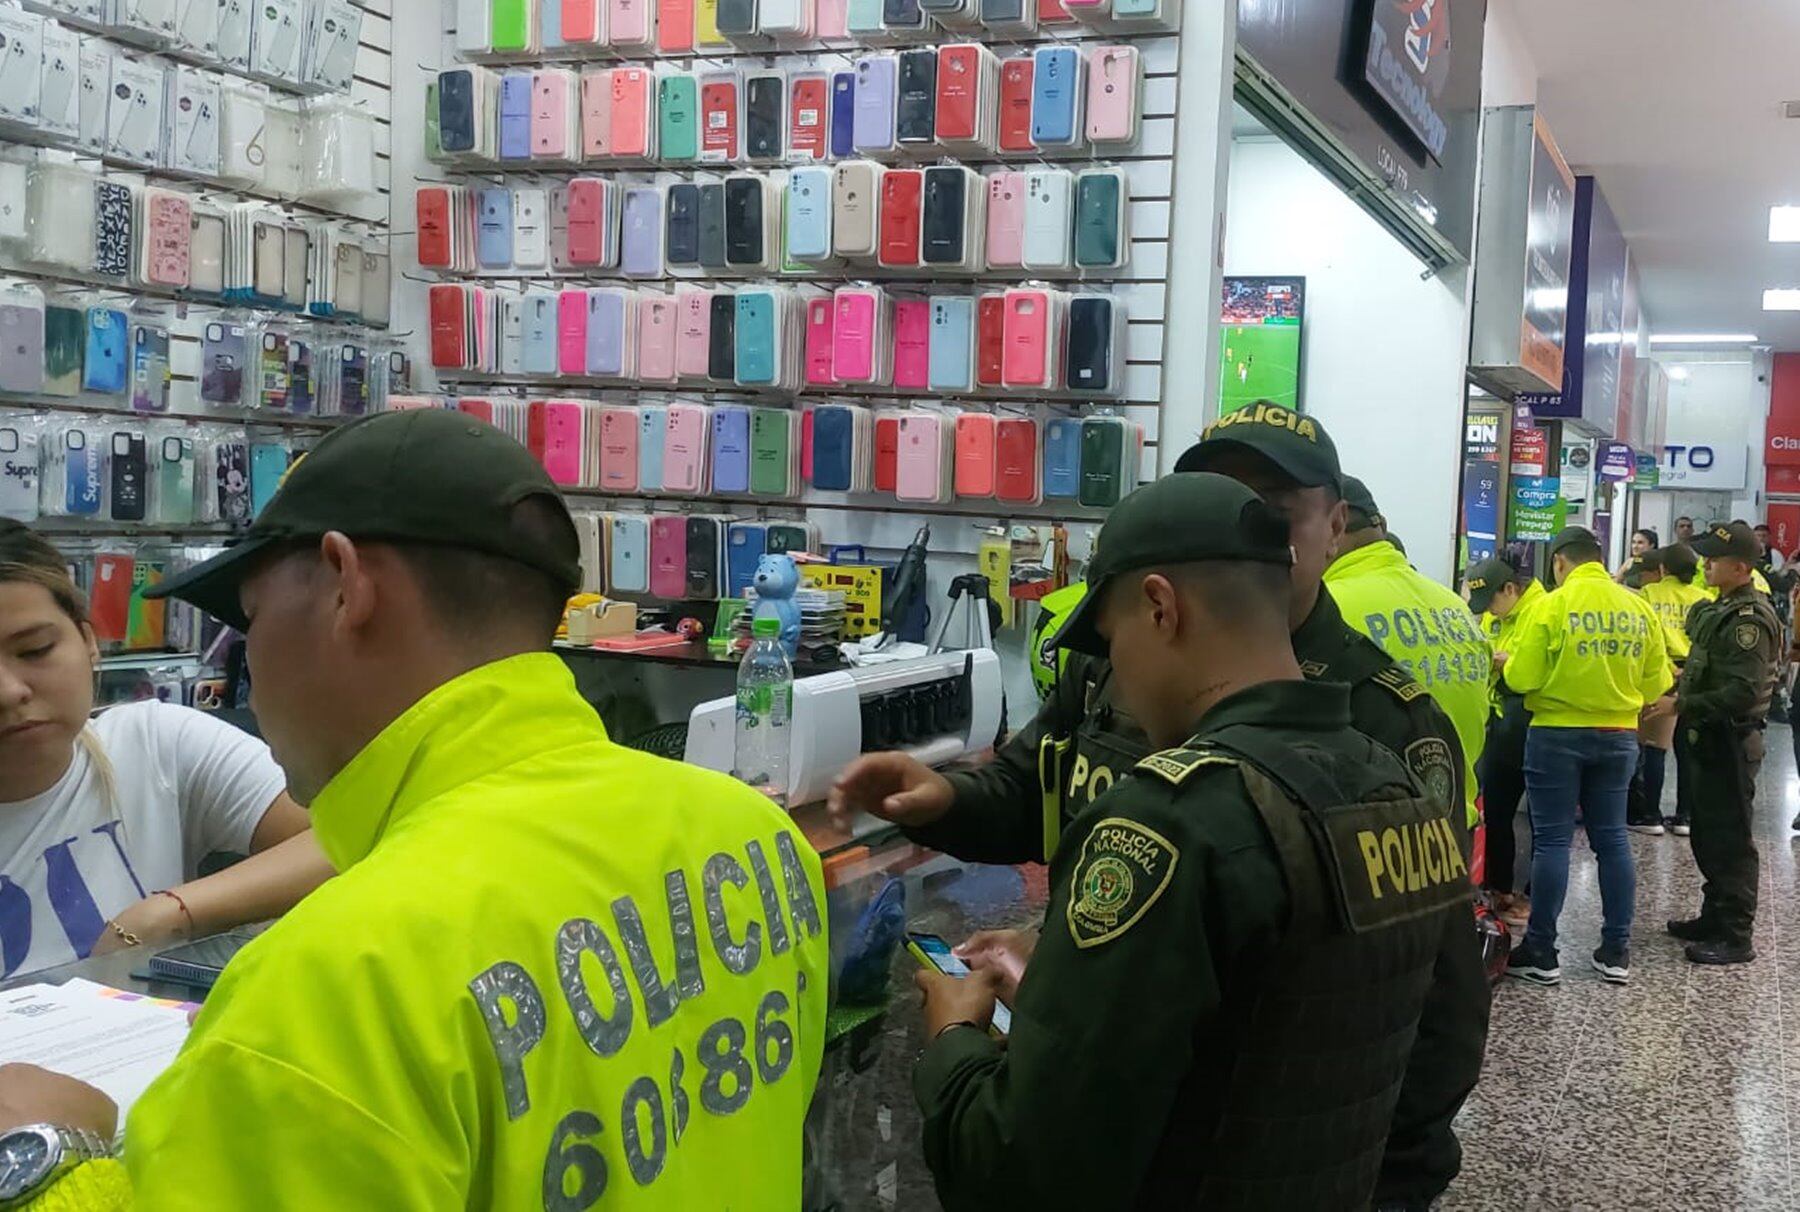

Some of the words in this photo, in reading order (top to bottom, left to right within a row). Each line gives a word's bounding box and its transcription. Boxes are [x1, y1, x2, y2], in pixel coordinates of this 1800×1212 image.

[1467, 424, 1497, 443] ON
[83, 441, 100, 502] Suprem
[1517, 487, 1556, 500] Compra
[1569, 611, 1647, 637] POLICIA
[1094, 840, 1156, 875] NACIONAL
[1101, 829, 1158, 859] POLICIA
[1357, 818, 1467, 898] POLICIA
[468, 830, 822, 1121] POLICIA
